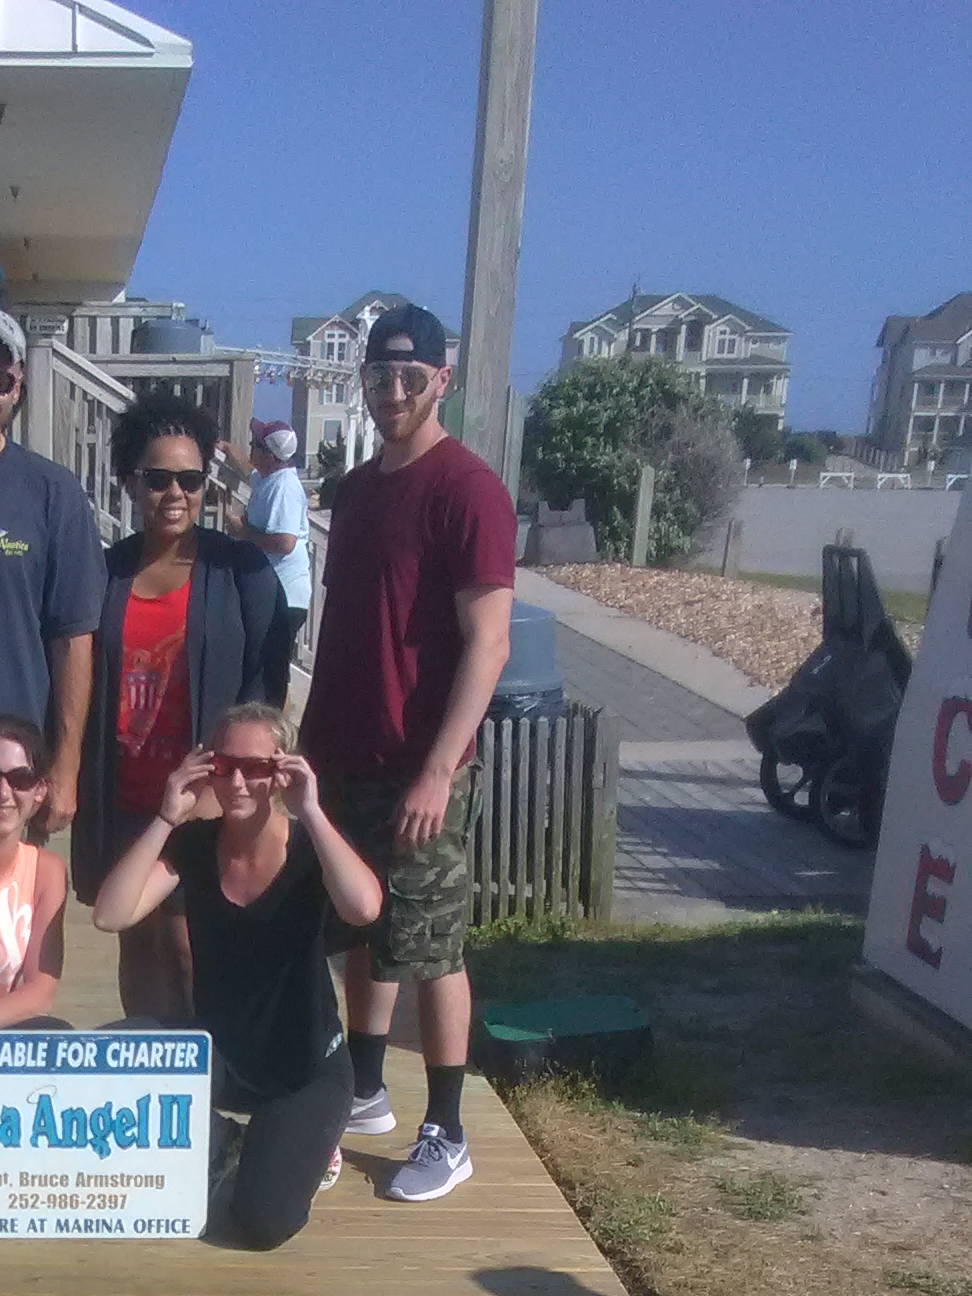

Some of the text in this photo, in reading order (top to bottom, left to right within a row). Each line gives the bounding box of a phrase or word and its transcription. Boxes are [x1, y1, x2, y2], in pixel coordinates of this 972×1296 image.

[56, 1042, 98, 1068] FOR
[106, 1041, 199, 1068] CHARTER
[30, 1094, 152, 1160] Angel
[158, 1094, 193, 1149] II
[19, 1171, 69, 1188] Bruce
[76, 1171, 165, 1190] Armstrong
[8, 1193, 128, 1210] 252-986-2397
[27, 1218, 47, 1234] AT
[55, 1218, 125, 1234] MARINA
[133, 1218, 191, 1234] OFFICE
